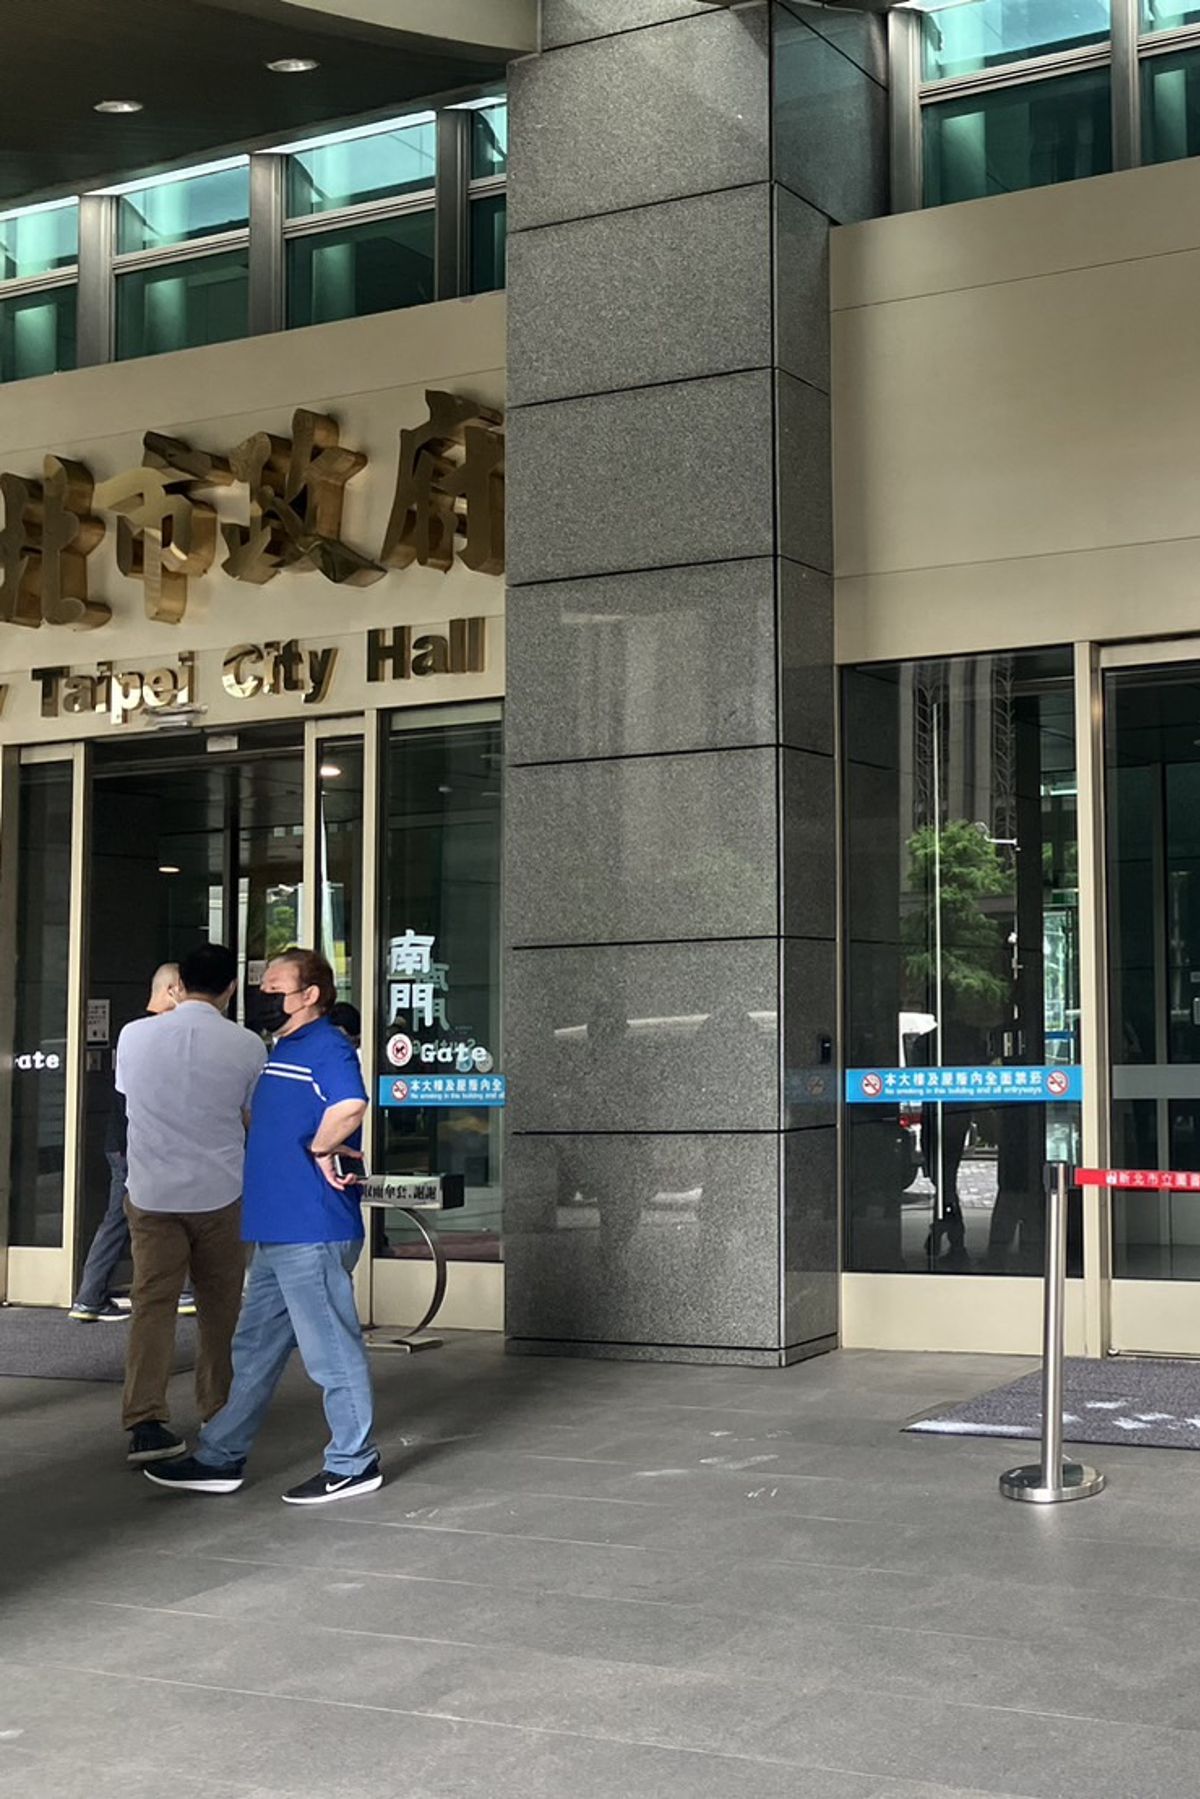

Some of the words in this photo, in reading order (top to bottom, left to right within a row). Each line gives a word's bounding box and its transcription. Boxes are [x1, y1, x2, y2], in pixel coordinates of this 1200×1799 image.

[32, 650, 196, 724] Taipei
[222, 638, 339, 703] City
[366, 616, 486, 683] Hall
[389, 929, 435, 1027] 南門
[15, 1051, 60, 1069] ate
[421, 1042, 487, 1062] Gate
